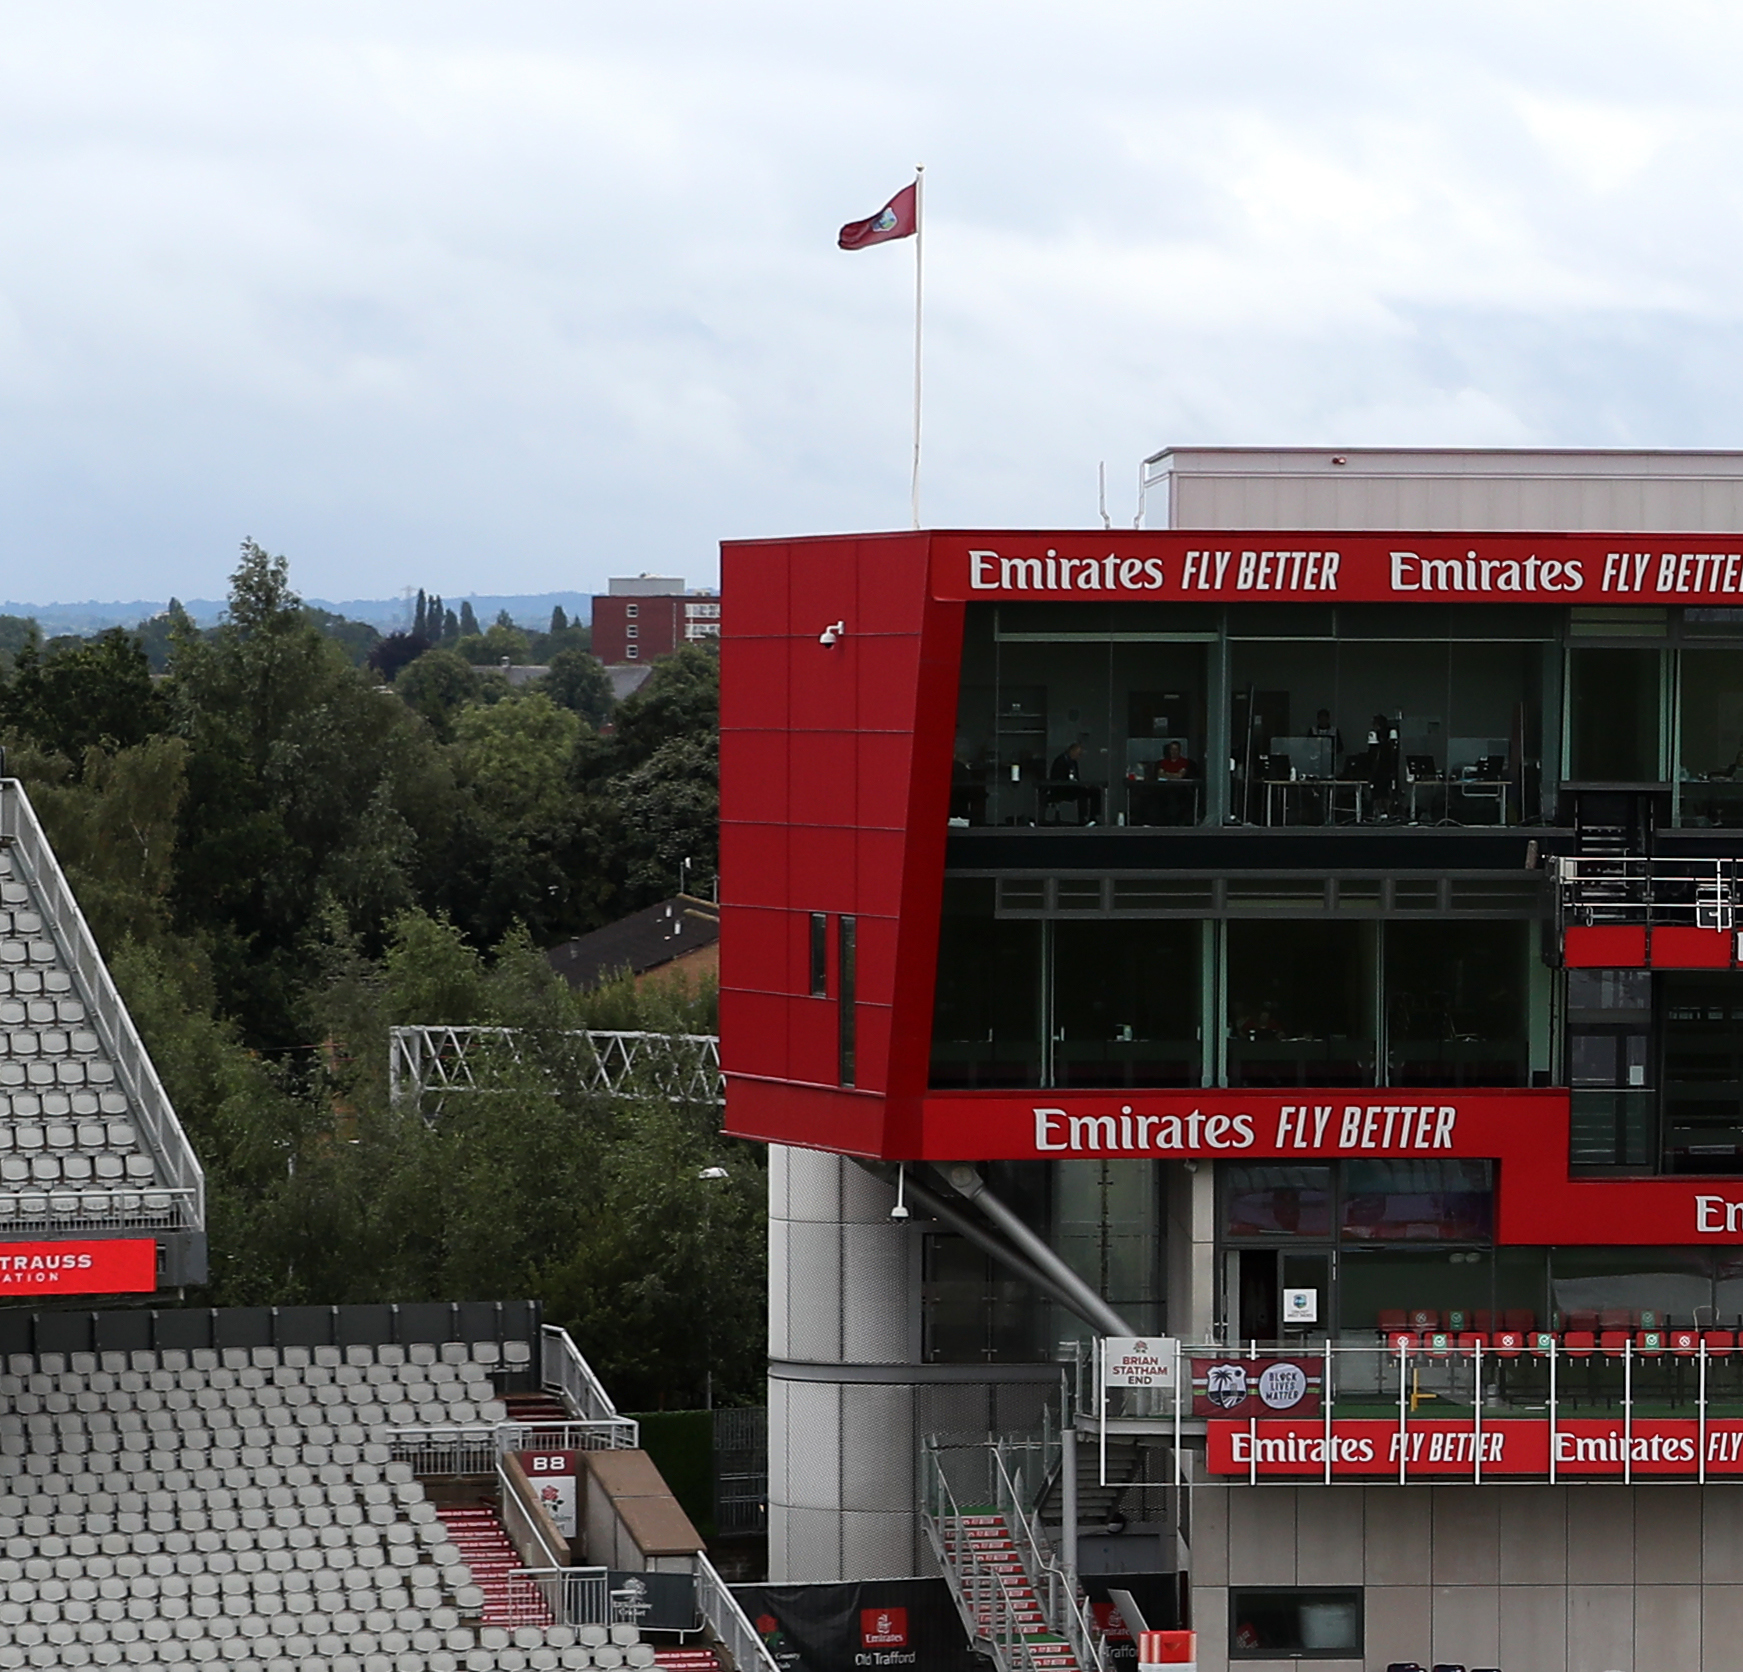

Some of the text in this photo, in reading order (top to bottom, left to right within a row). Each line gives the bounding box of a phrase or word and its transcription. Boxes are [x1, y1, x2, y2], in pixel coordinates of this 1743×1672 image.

[969, 550, 1339, 589] Emirates FLY BETTER
[1390, 551, 1583, 590] Emirates
[1602, 554, 1650, 591] FLY
[1033, 1106, 1455, 1150] Emirates FLY BETTER
[1122, 1356, 1158, 1365] BRIAN
[1112, 1365, 1168, 1375] STATHAM
[1127, 1375, 1152, 1385] END
[1270, 1382, 1295, 1390] LIVES
[1265, 1390, 1299, 1401] MATTER
[1231, 1432, 1504, 1462] Emirates BETTER
[1553, 1431, 1694, 1462] Emirates
[1707, 1432, 1743, 1462] FLY
[533, 1456, 565, 1470] B8
[865, 1633, 903, 1643] Emirates
[854, 1651, 917, 1666] Old Trafford
